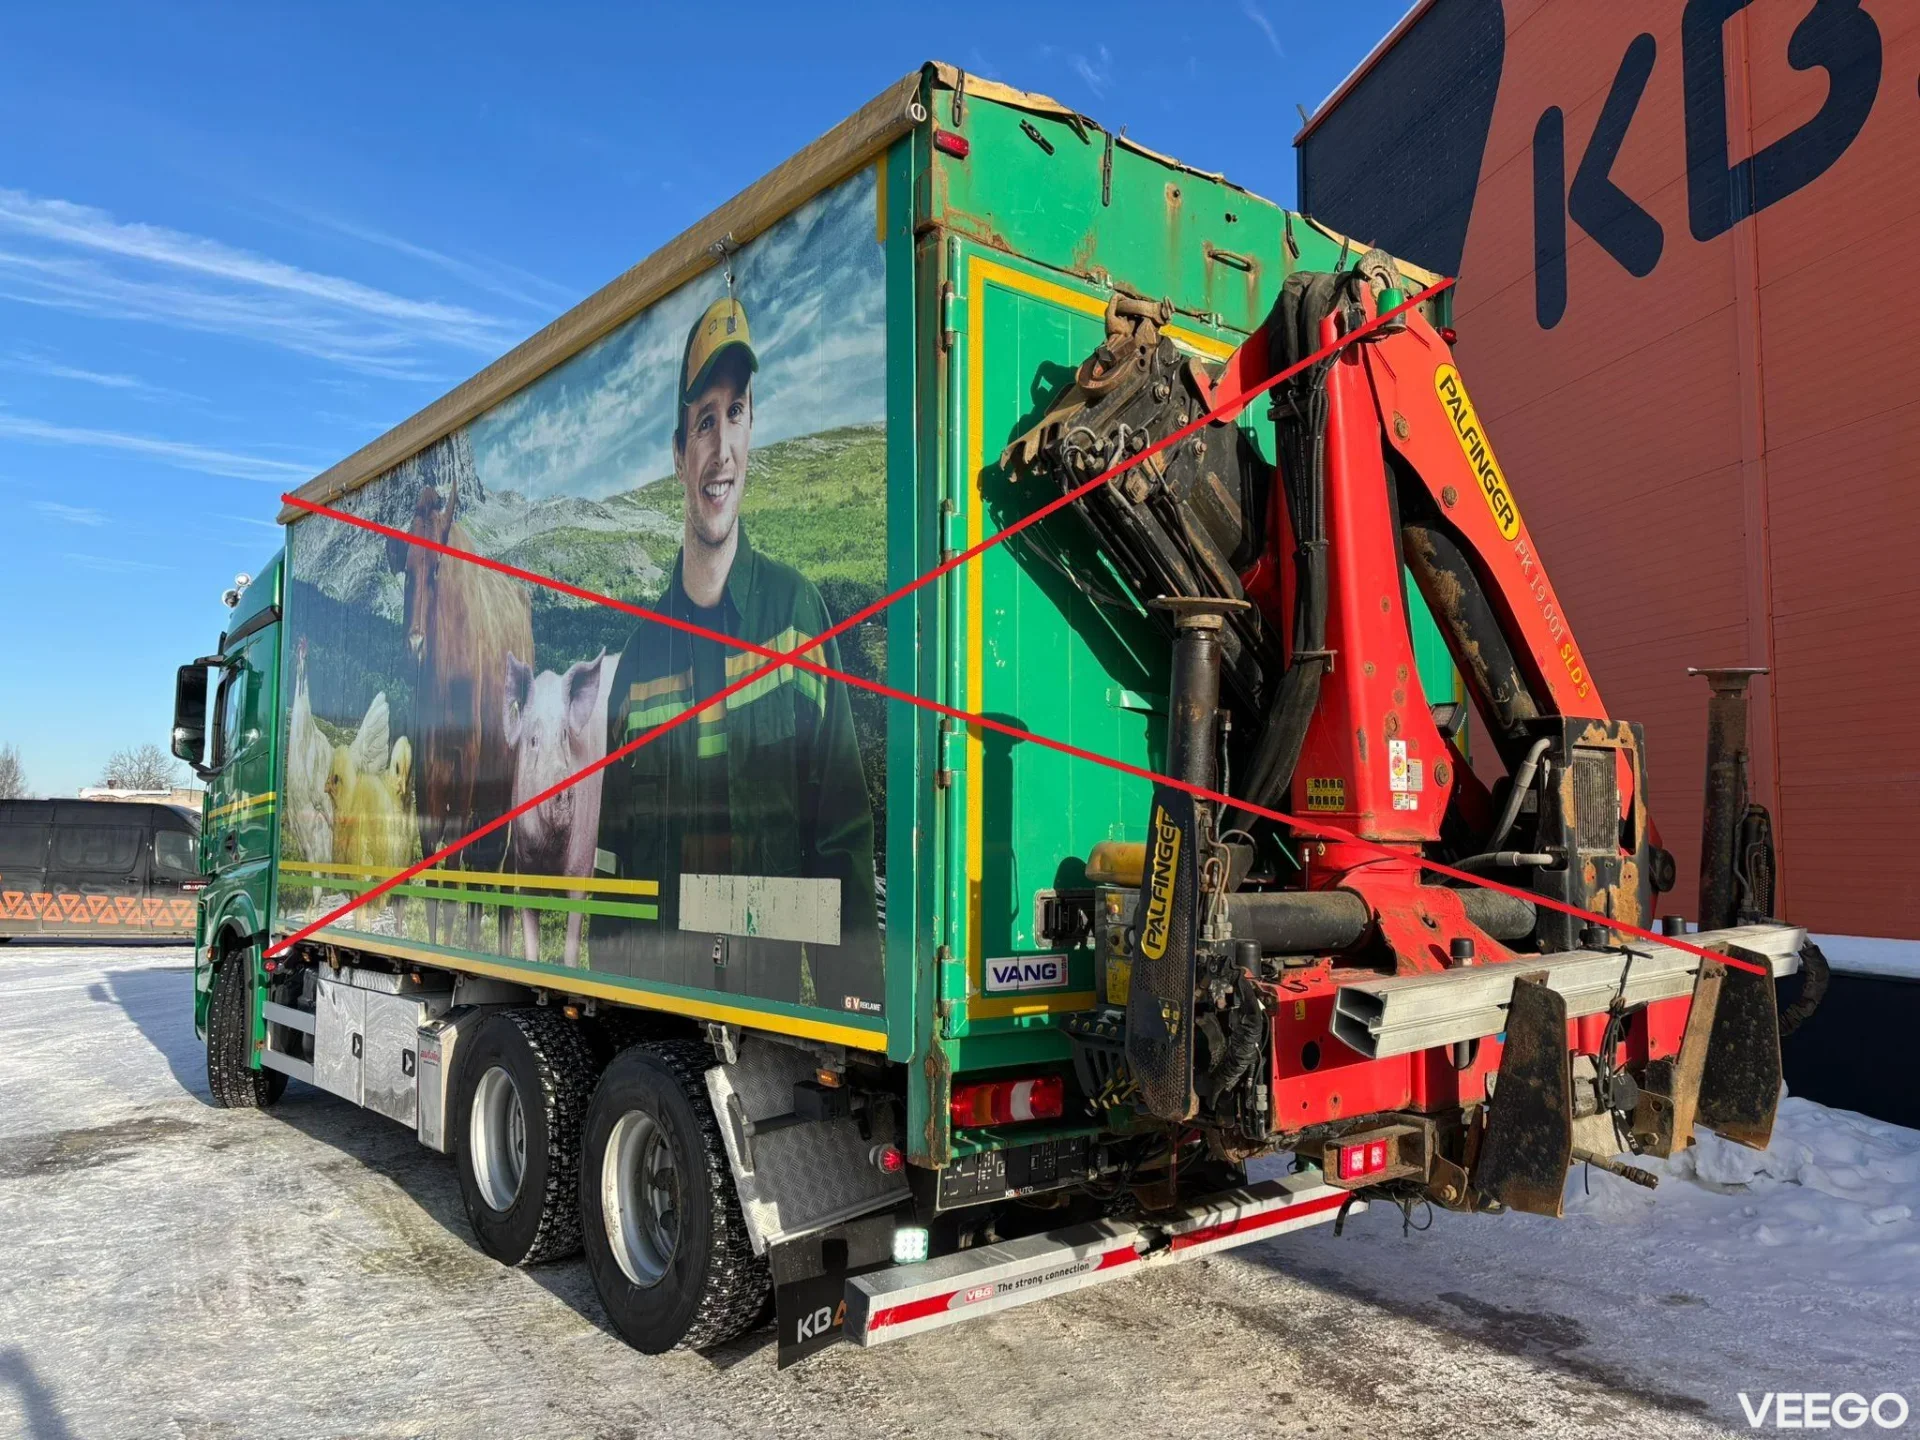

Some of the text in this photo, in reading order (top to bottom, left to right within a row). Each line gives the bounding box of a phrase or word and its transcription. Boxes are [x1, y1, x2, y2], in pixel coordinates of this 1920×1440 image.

[1532, 0, 1920, 330] KB
[1439, 374, 1515, 531] PALFINGER
[1514, 540, 1534, 575] PK
[1530, 573, 1564, 643] 19.001
[992, 962, 1057, 983] VANG
[997, 1282, 1013, 1293] The
[1015, 1274, 1043, 1288] strong
[1045, 1262, 1090, 1281] connection
